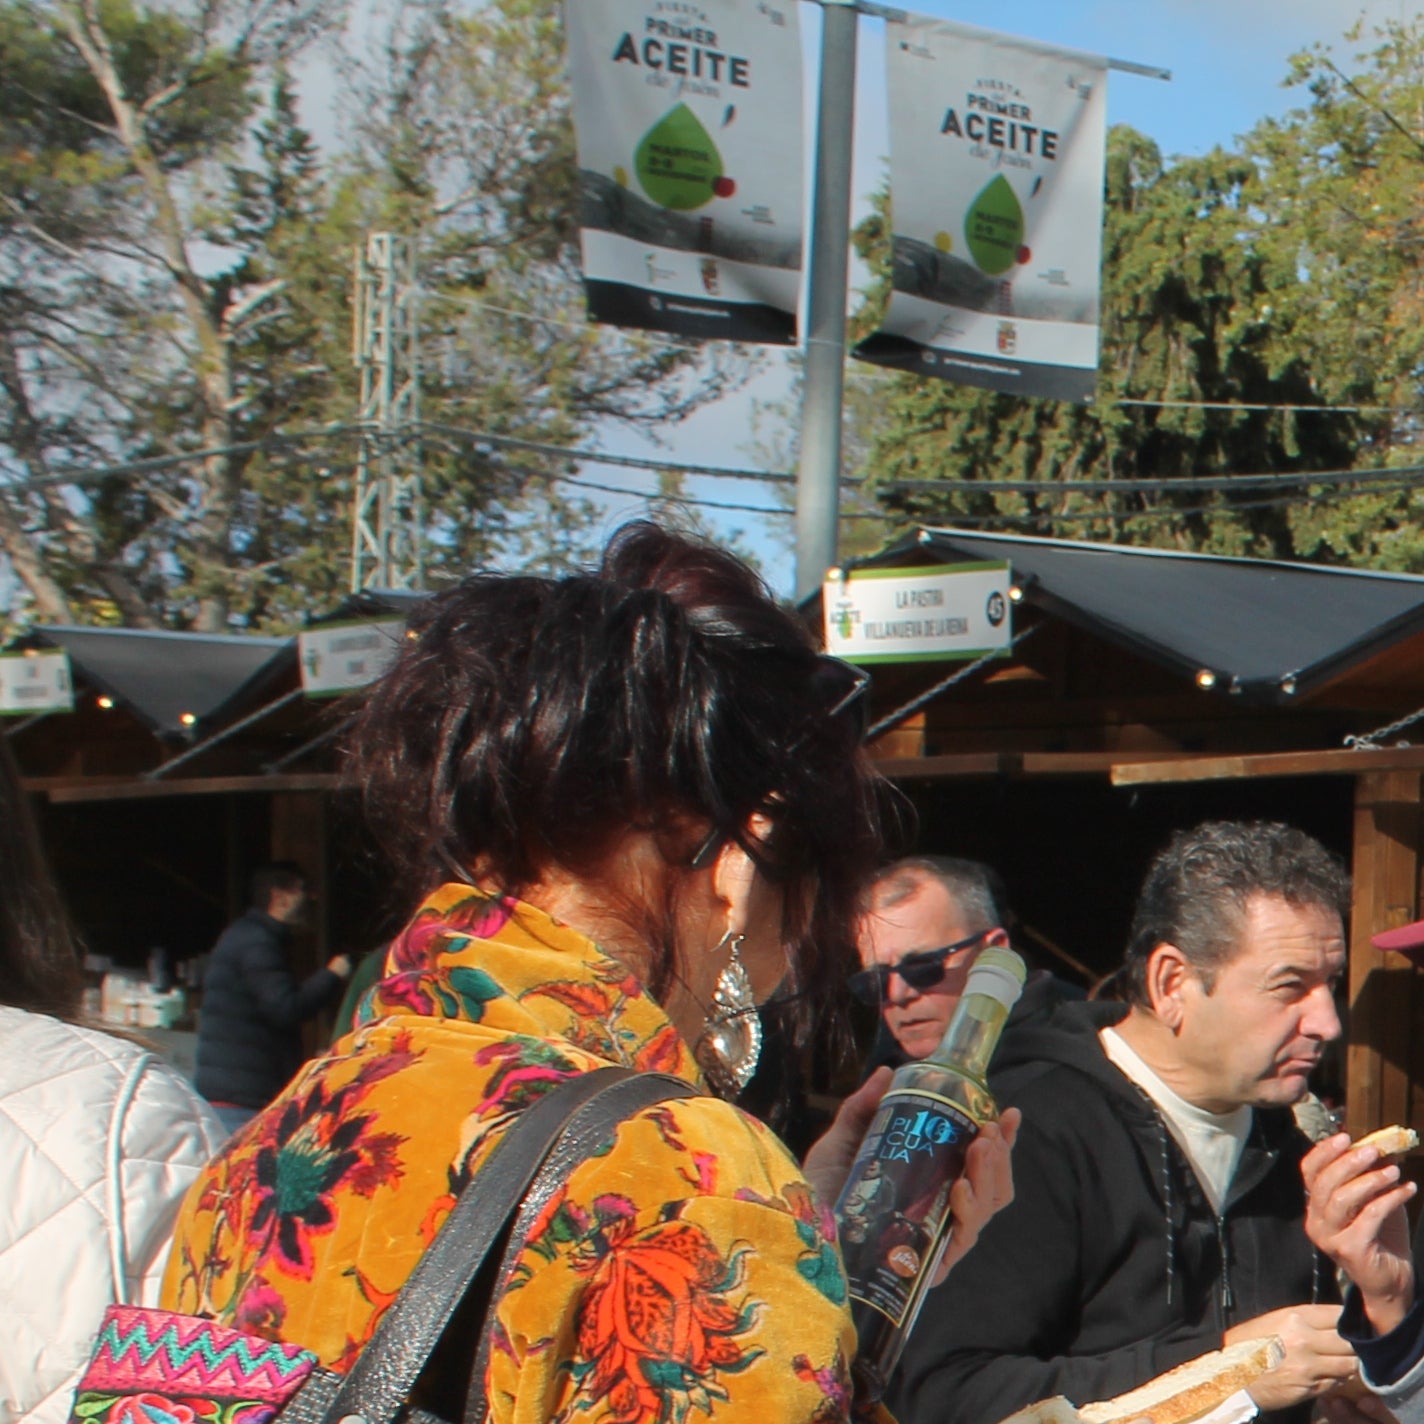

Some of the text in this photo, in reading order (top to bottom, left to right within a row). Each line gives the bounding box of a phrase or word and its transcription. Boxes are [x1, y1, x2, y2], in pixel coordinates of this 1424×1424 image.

[645, 16, 717, 46] PRIMER
[612, 32, 750, 88] ACEITE
[967, 92, 1032, 121] PRIMER
[941, 107, 1059, 160] ACEITE
